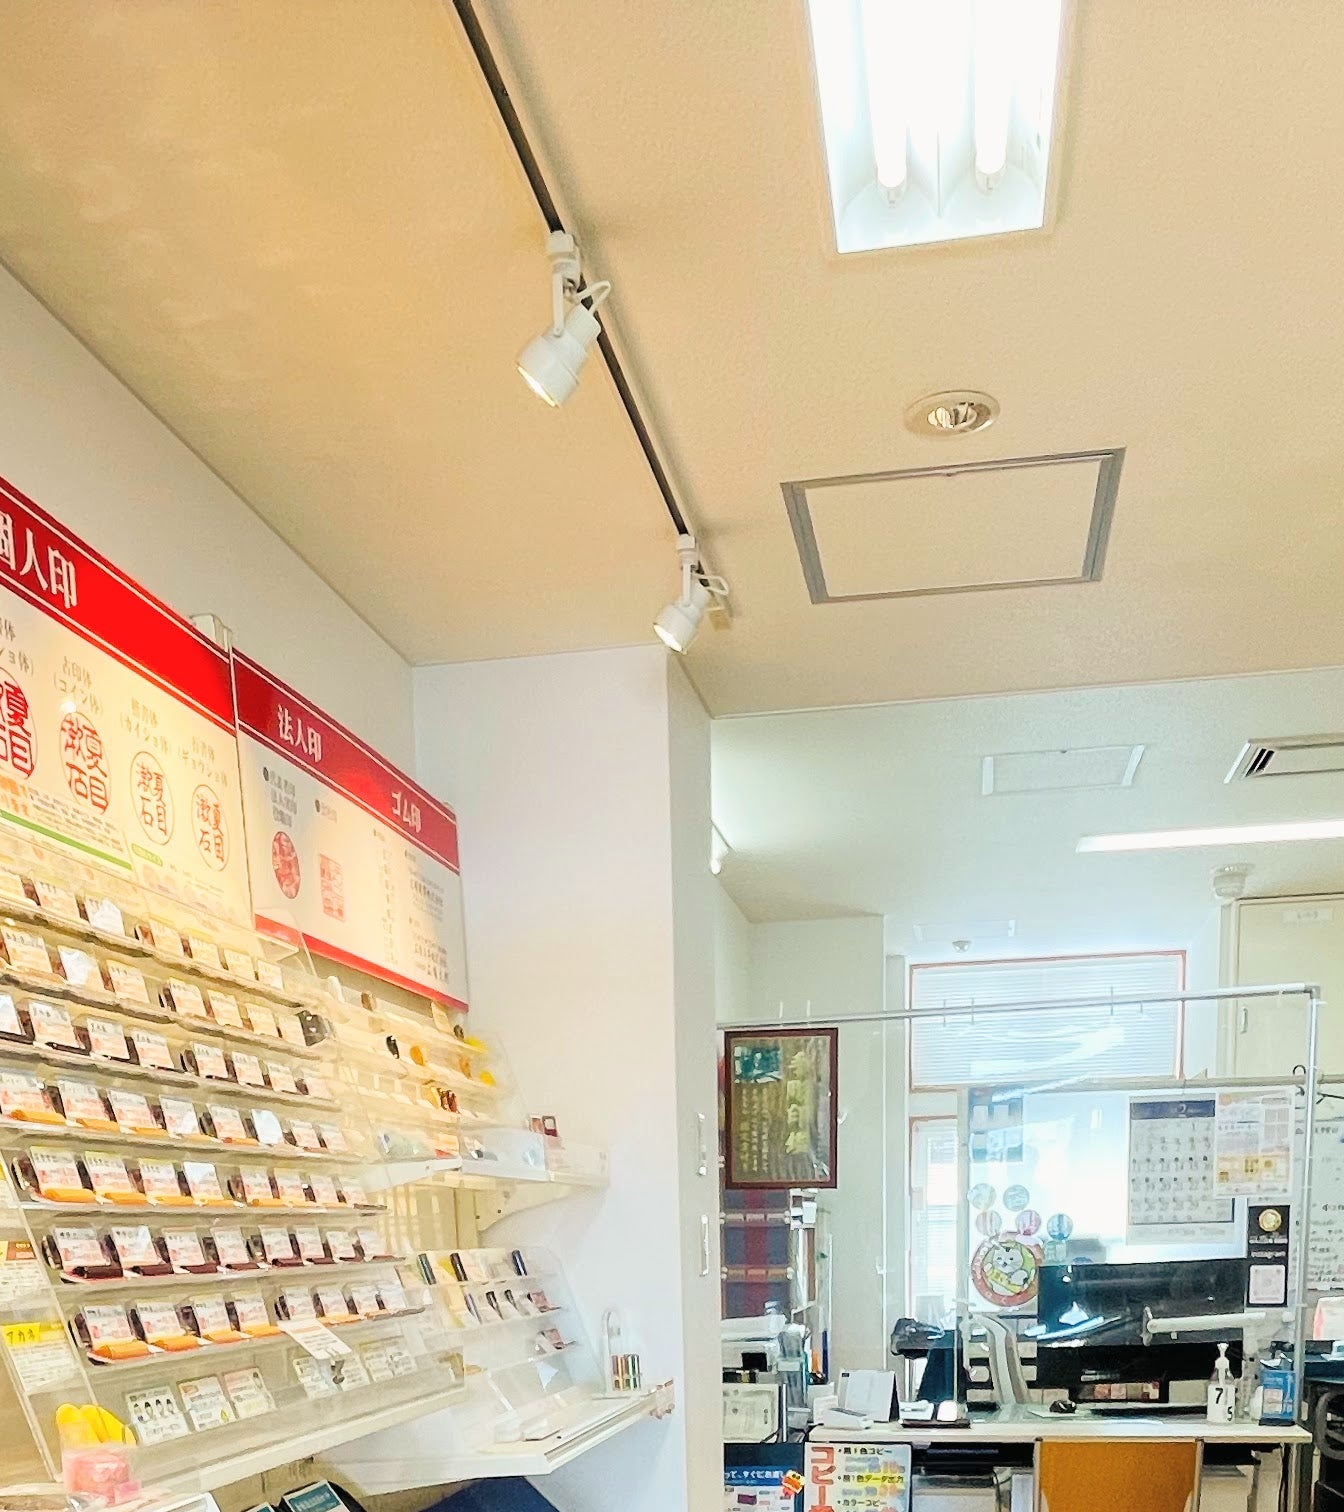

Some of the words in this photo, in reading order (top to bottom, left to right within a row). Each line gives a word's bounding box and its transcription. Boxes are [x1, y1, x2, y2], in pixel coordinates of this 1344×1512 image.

[276, 704, 323, 763] 法人印
[391, 790, 422, 834] ゴム印
